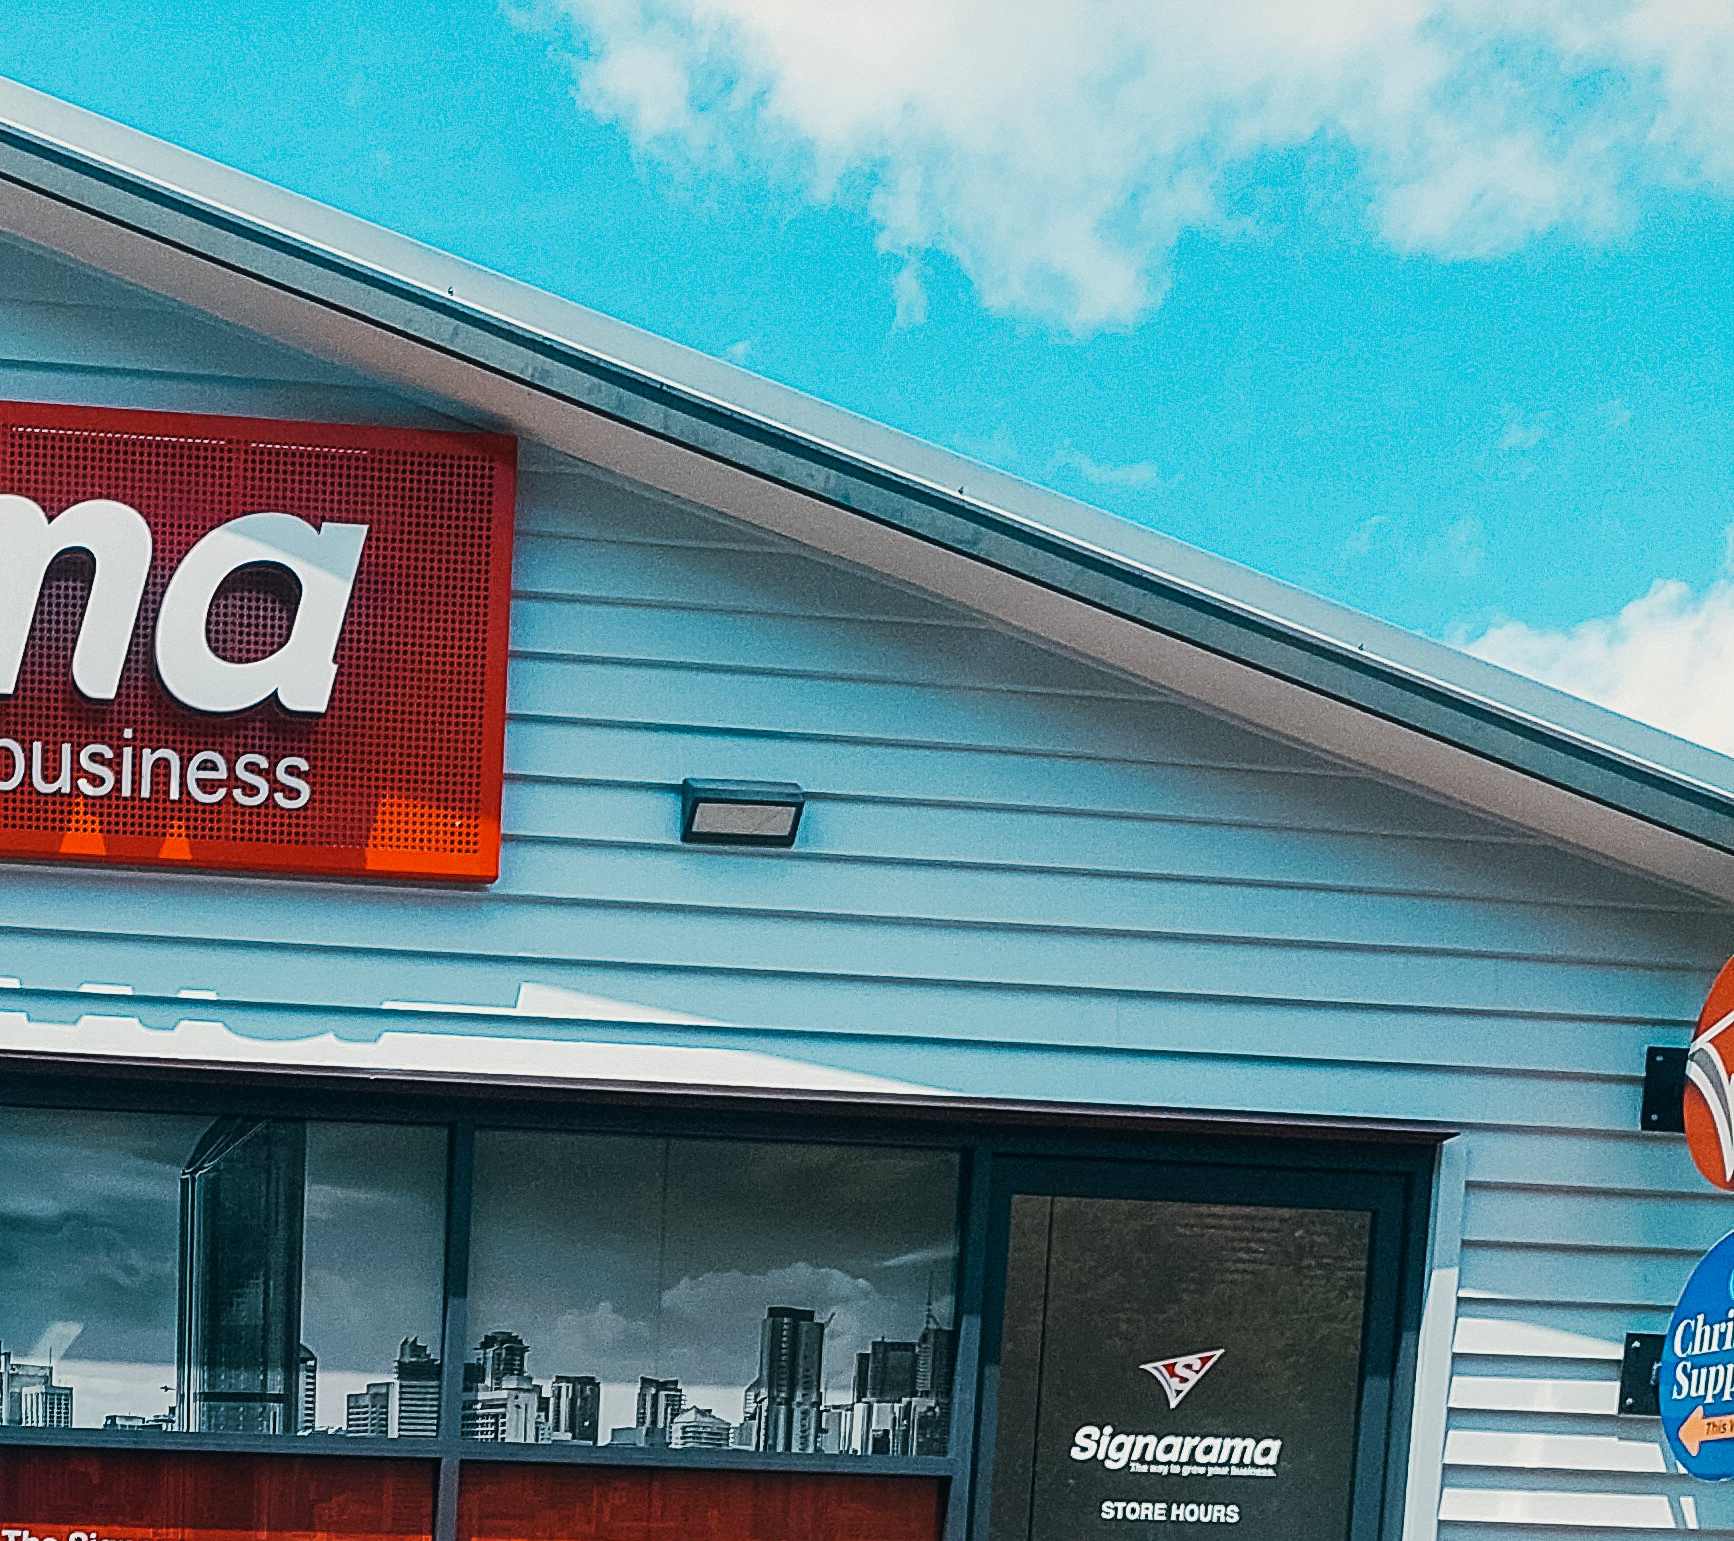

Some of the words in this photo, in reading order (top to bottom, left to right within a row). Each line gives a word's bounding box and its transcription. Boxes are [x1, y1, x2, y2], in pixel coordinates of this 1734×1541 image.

[1070, 1425, 1282, 1469] Signarama
[1129, 1461, 1148, 1472] The
[1101, 1501, 1167, 1520] STORE
[1170, 1503, 1240, 1523] HOURS
